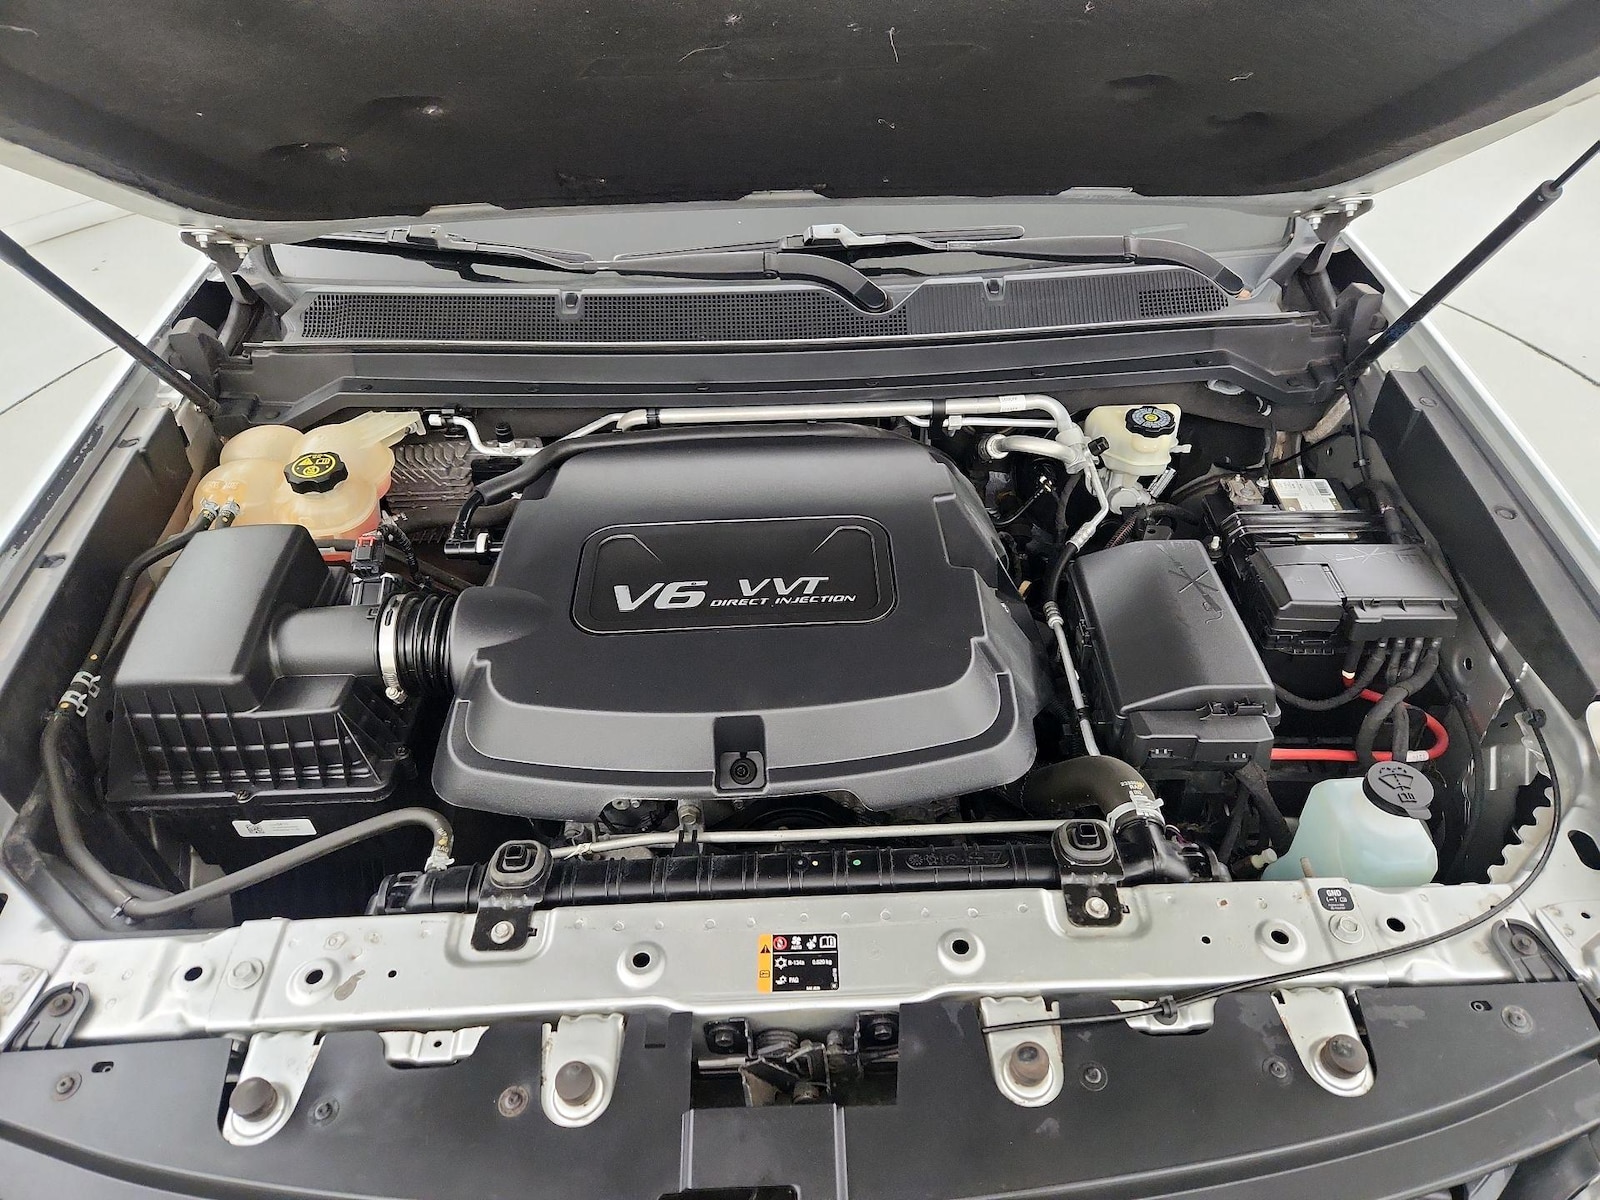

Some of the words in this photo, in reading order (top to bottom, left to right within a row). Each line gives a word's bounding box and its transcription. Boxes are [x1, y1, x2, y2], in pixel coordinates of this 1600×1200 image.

[613, 580, 708, 612] V6
[738, 577, 829, 596] VVT
[710, 597, 769, 608] DIRECT
[774, 594, 856, 605] INJECTION
